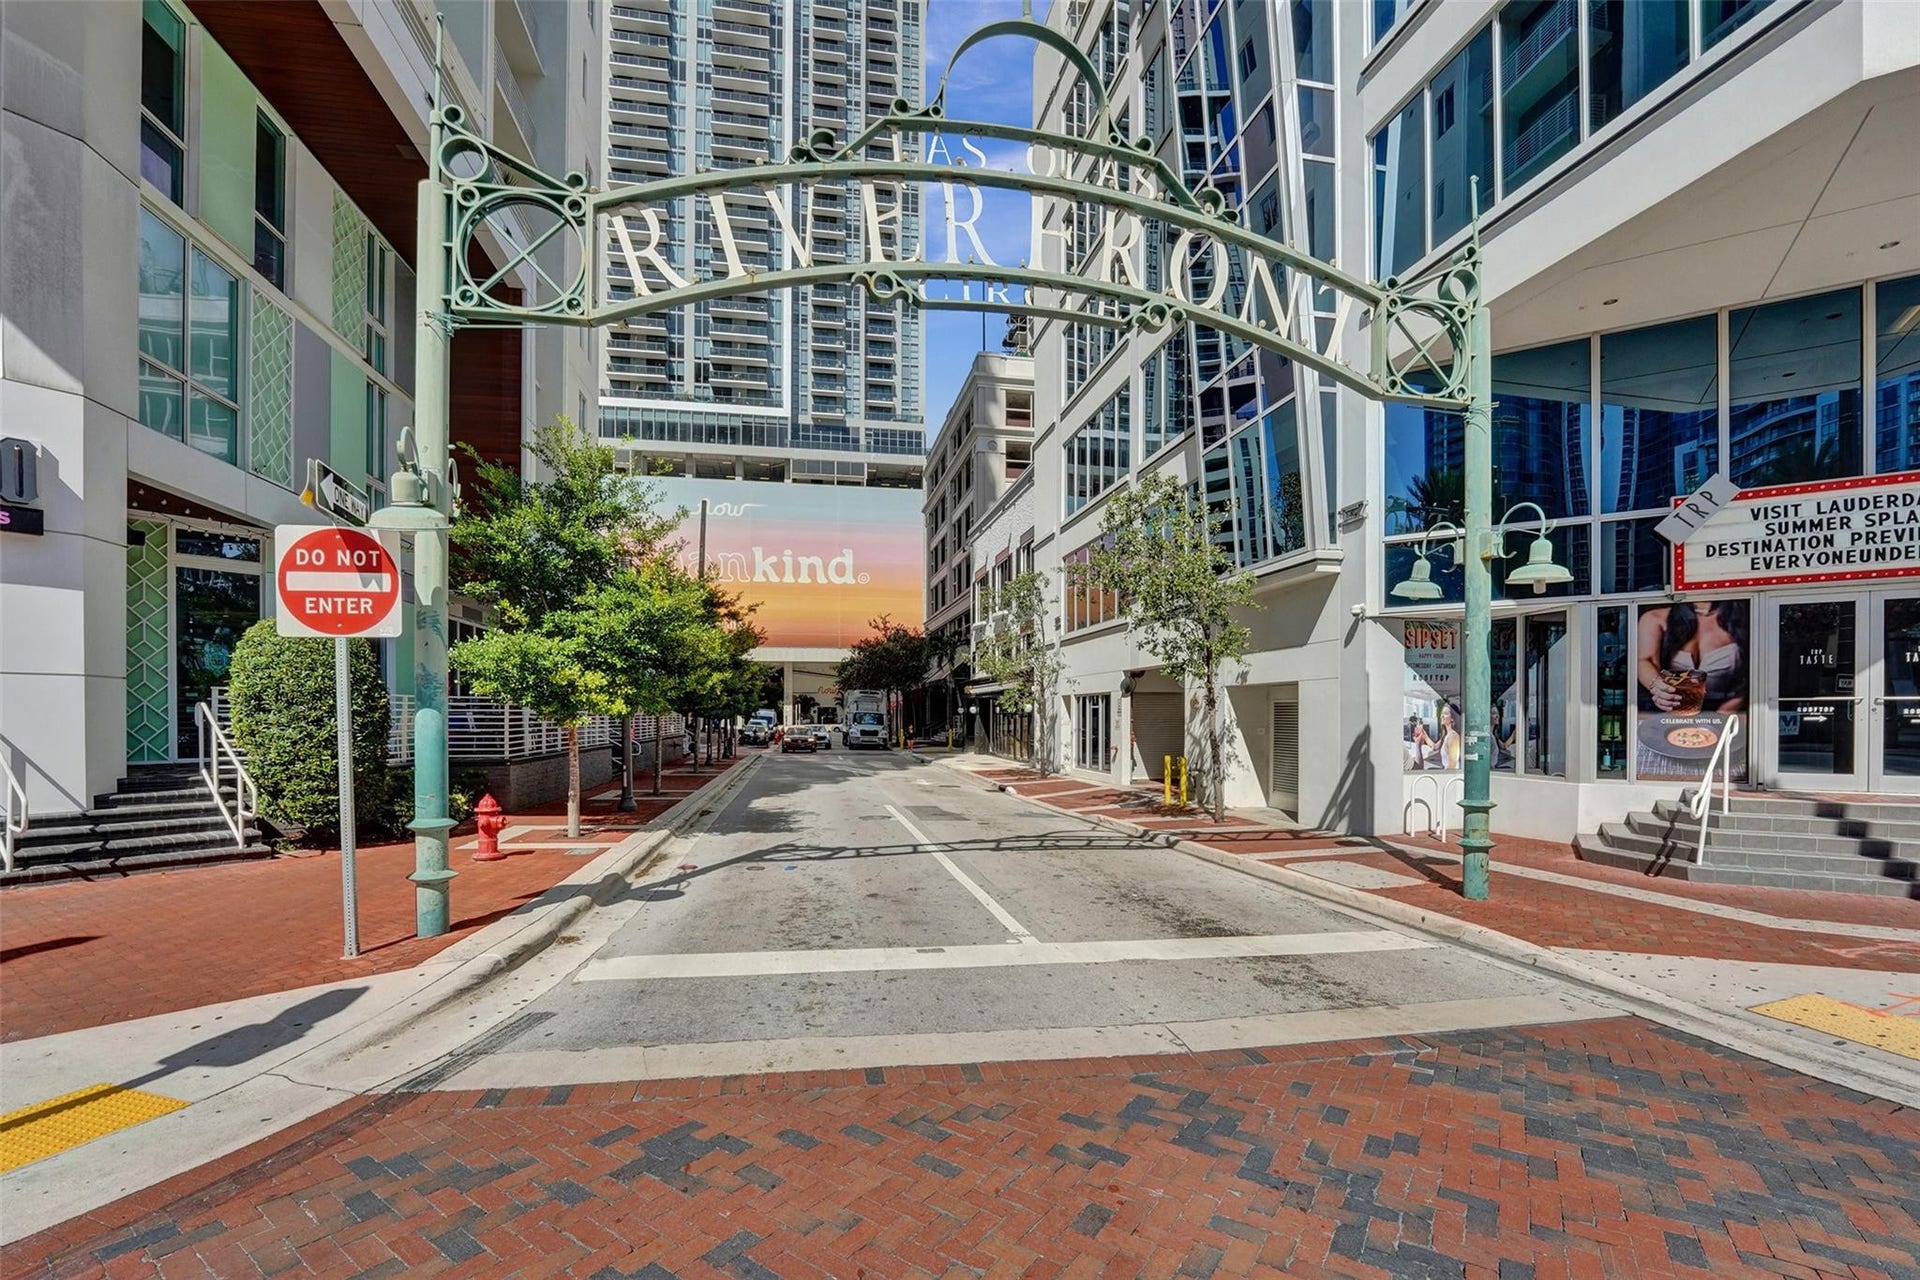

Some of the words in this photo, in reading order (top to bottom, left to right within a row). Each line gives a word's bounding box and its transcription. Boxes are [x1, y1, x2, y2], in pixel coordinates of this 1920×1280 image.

[596, 173, 1376, 365] RIVERFRONT
[335, 486, 349, 509] ONE
[350, 496, 367, 520] WAY
[1673, 490, 1719, 529] TRP
[1750, 503, 1802, 521] VISIT
[1817, 492, 1920, 515] LAUDERD
[1765, 516, 1852, 536] SUMMER
[1705, 533, 1835, 558] DESTINATION
[1851, 527, 1920, 546] PREVI
[296, 549, 325, 566] DO
[337, 550, 380, 567] NOT
[1750, 545, 1920, 571] EVERYONEUNDE
[305, 597, 373, 615] ENTER
[1404, 628, 1458, 650] SIPSET
[1800, 655, 1833, 664] TASTE
